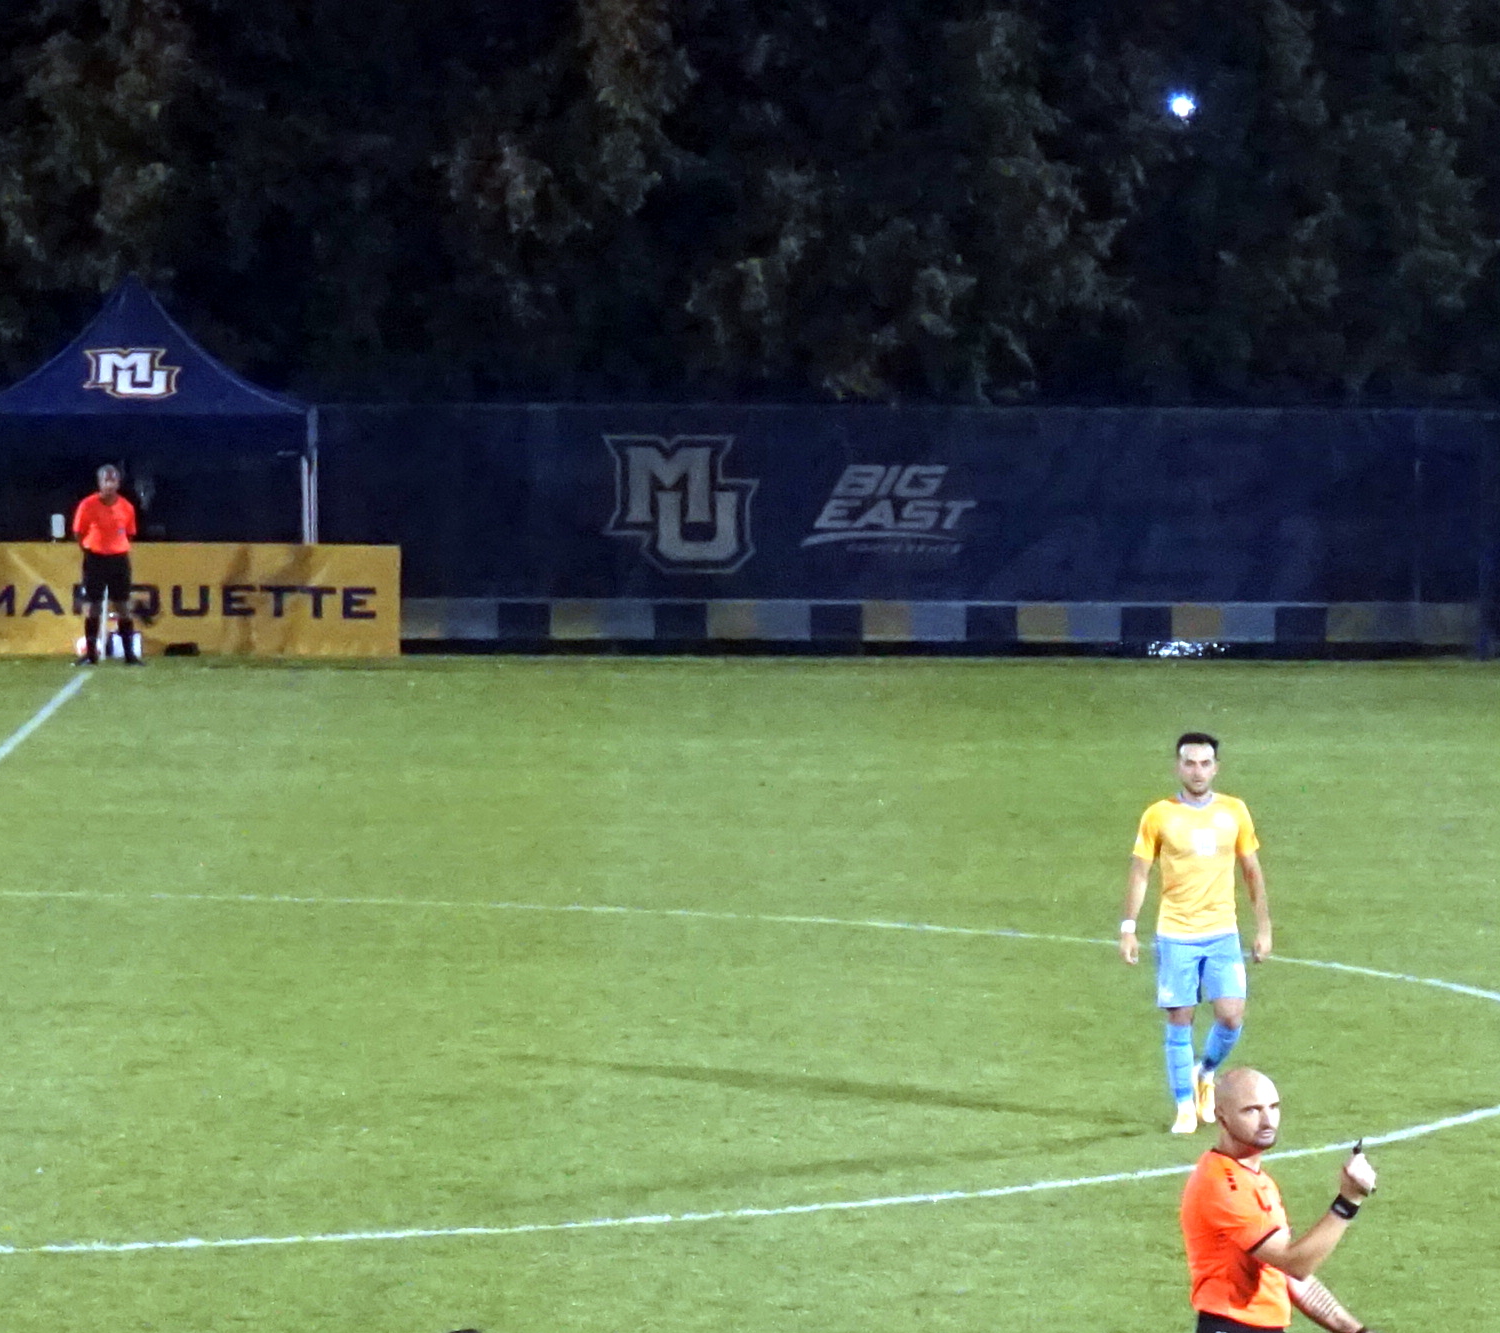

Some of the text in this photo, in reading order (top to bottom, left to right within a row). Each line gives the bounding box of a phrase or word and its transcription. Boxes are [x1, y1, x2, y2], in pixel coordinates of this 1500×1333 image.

[93, 351, 174, 396] MU
[830, 463, 949, 498] BIG
[614, 440, 749, 568] MU
[813, 498, 979, 530] EAST
